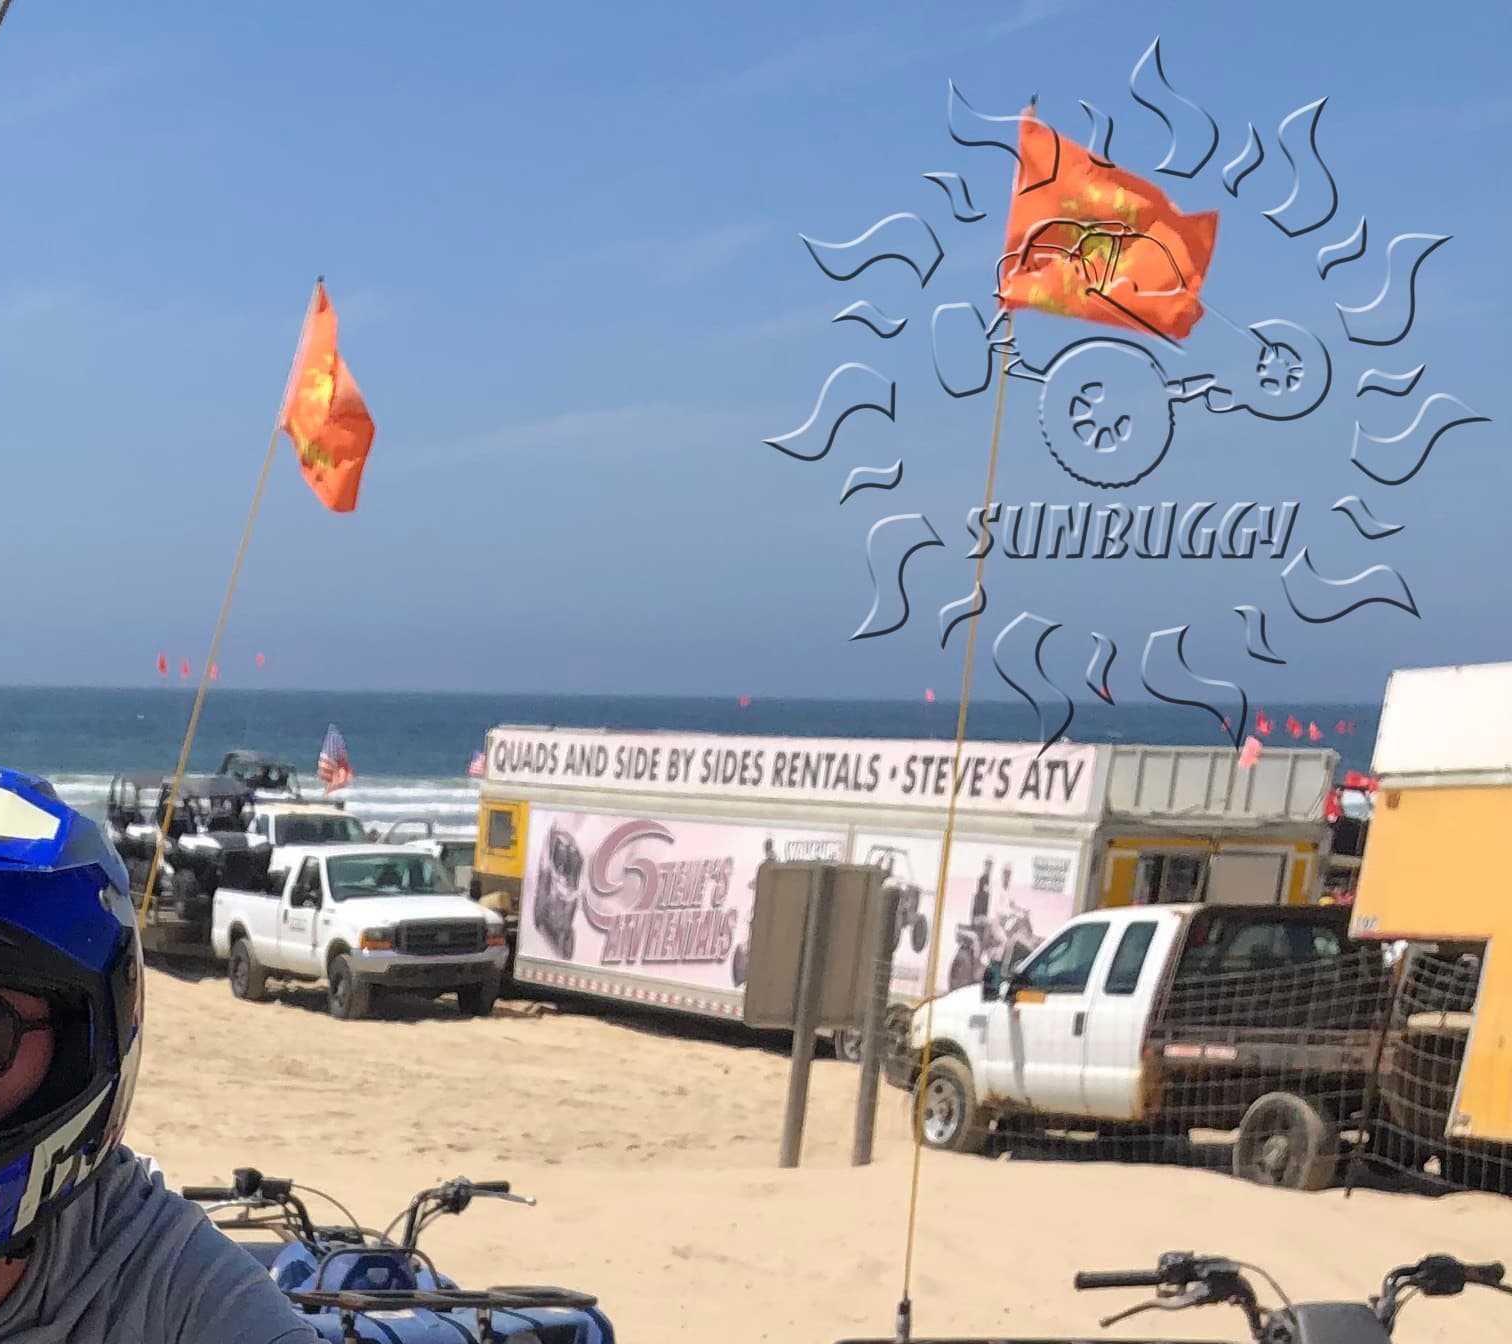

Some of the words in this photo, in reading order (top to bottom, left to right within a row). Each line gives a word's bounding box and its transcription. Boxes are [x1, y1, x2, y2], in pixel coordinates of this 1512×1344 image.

[493, 739, 560, 775] QUADS
[563, 742, 608, 778] AND
[614, 744, 660, 781] SIDE
[666, 747, 696, 783] BY
[699, 748, 764, 787] SIDES
[770, 750, 880, 793] RENTALS
[901, 754, 1012, 799] STEVE'S
[1018, 757, 1085, 802] ATV
[640, 907, 739, 965] RENTALS
